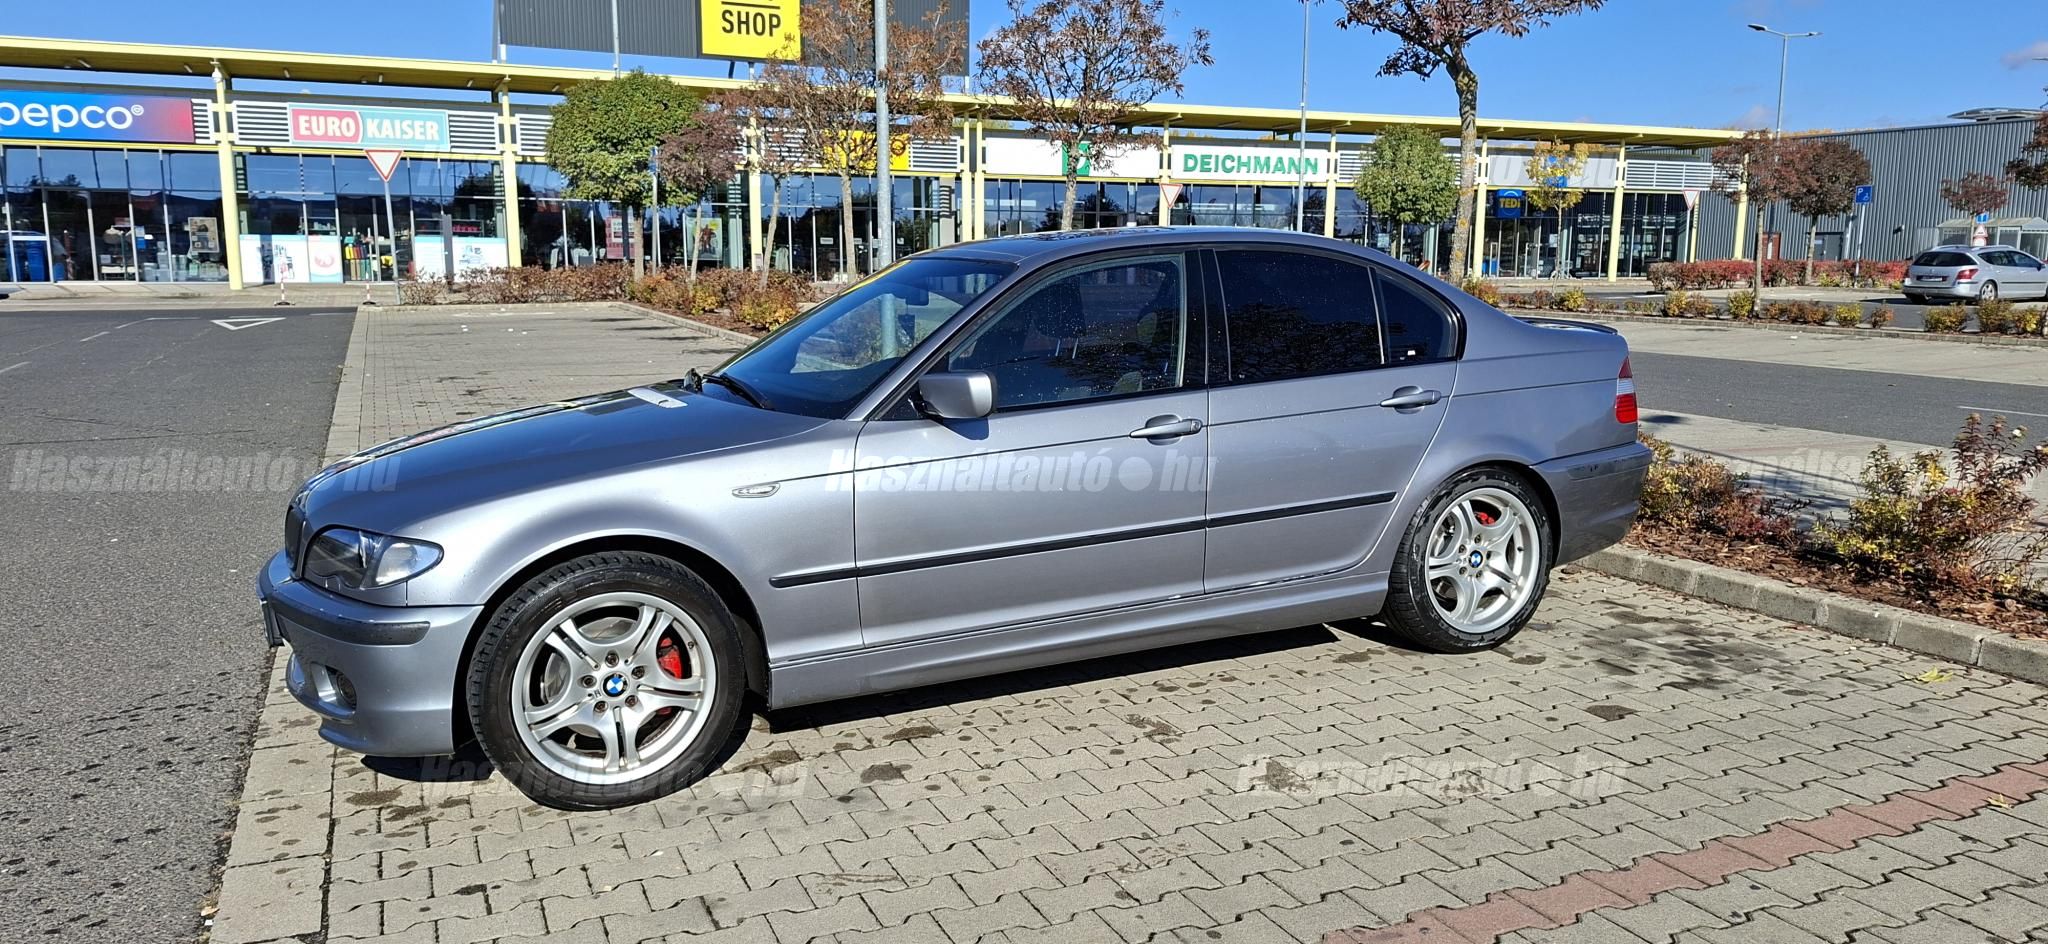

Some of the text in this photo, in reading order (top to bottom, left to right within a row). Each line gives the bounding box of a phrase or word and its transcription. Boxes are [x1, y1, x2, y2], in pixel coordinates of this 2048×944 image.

[721, 9, 782, 37] SHOP
[298, 114, 440, 141] EURO KAISER
[1183, 153, 1319, 175] DEICHMANN
[1857, 187, 1864, 196] P
